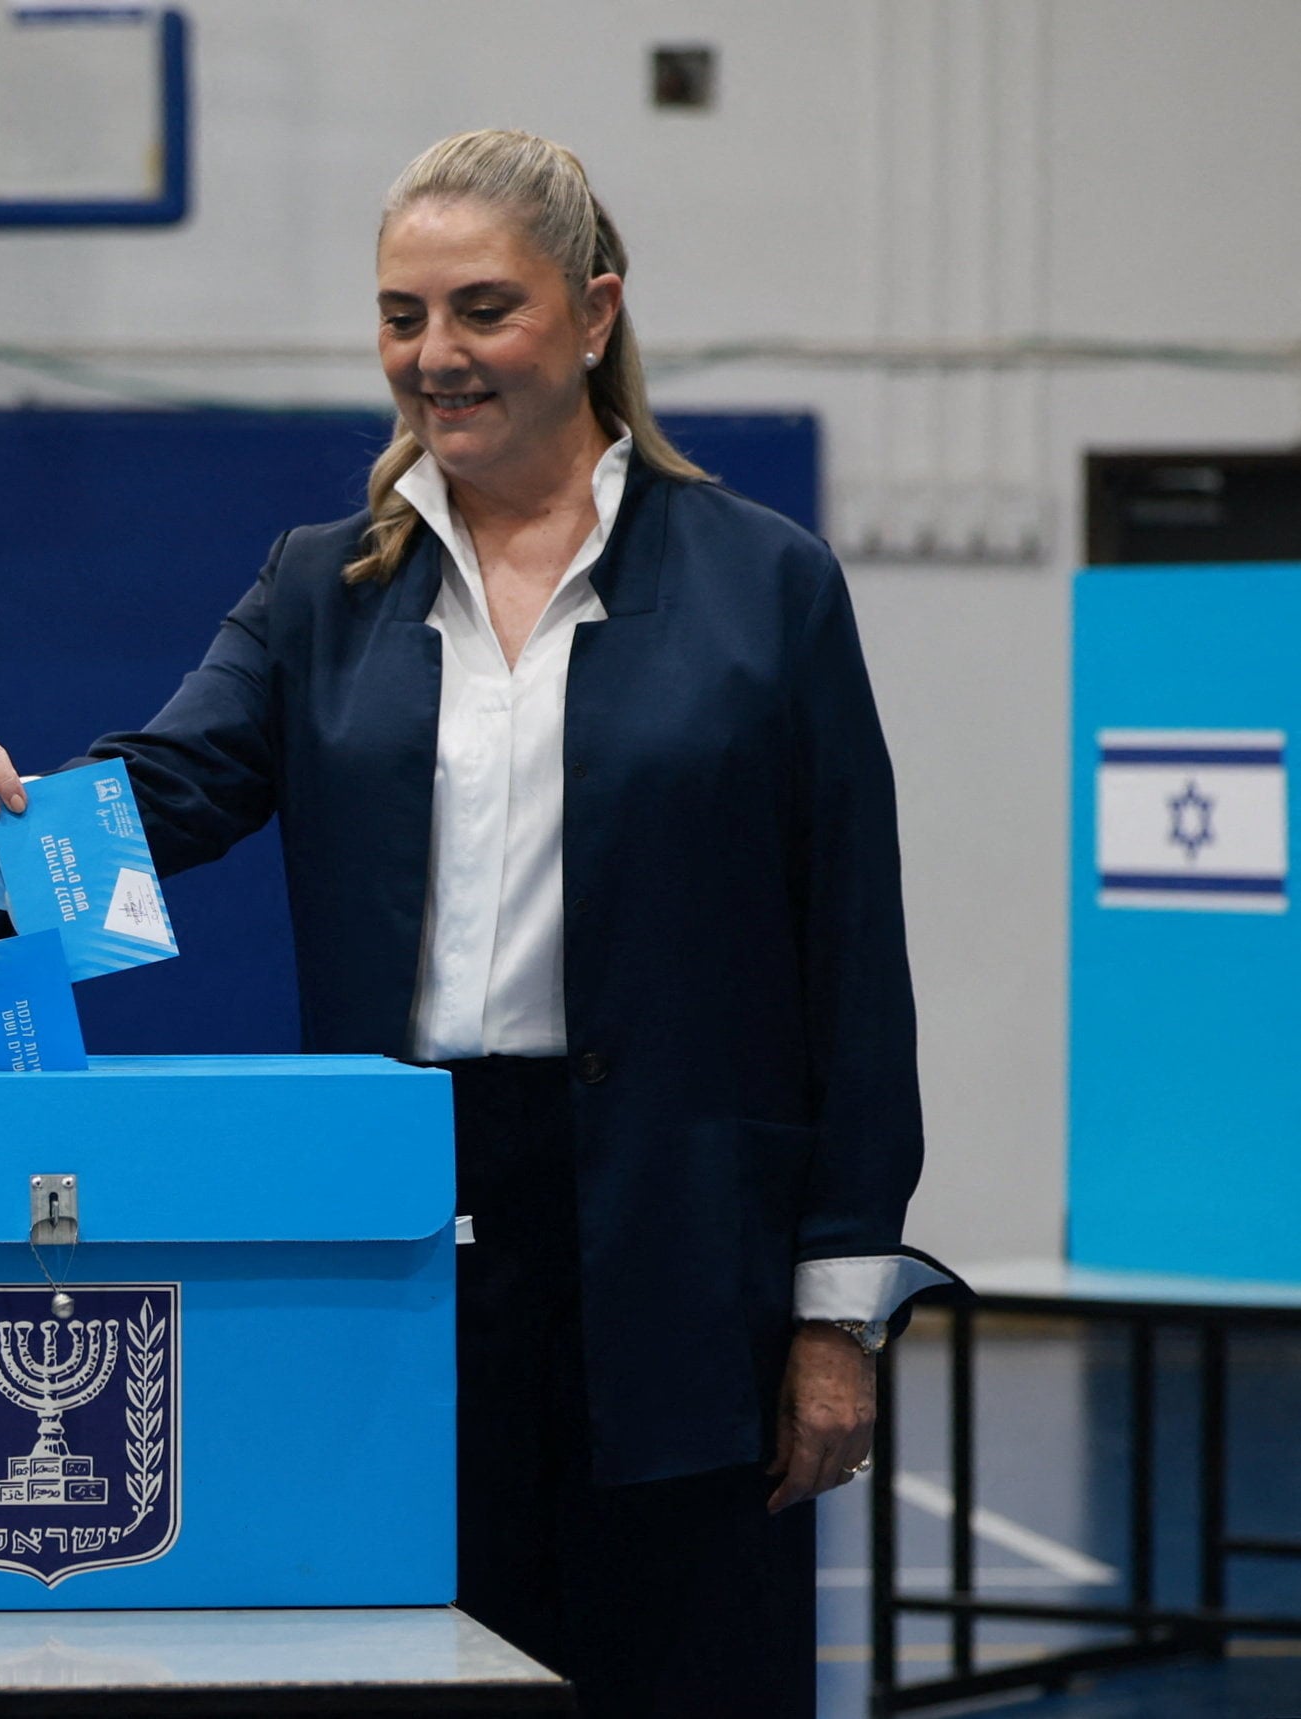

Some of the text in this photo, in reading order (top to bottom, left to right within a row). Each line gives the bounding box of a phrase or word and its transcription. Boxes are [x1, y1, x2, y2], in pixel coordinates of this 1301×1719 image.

[41, 835, 77, 922] הבחירות לכנסת
[58, 838, 89, 912] העשרים ושש
[2, 1010, 18, 1036] ושש
[15, 1000, 36, 1037] לכנסת
